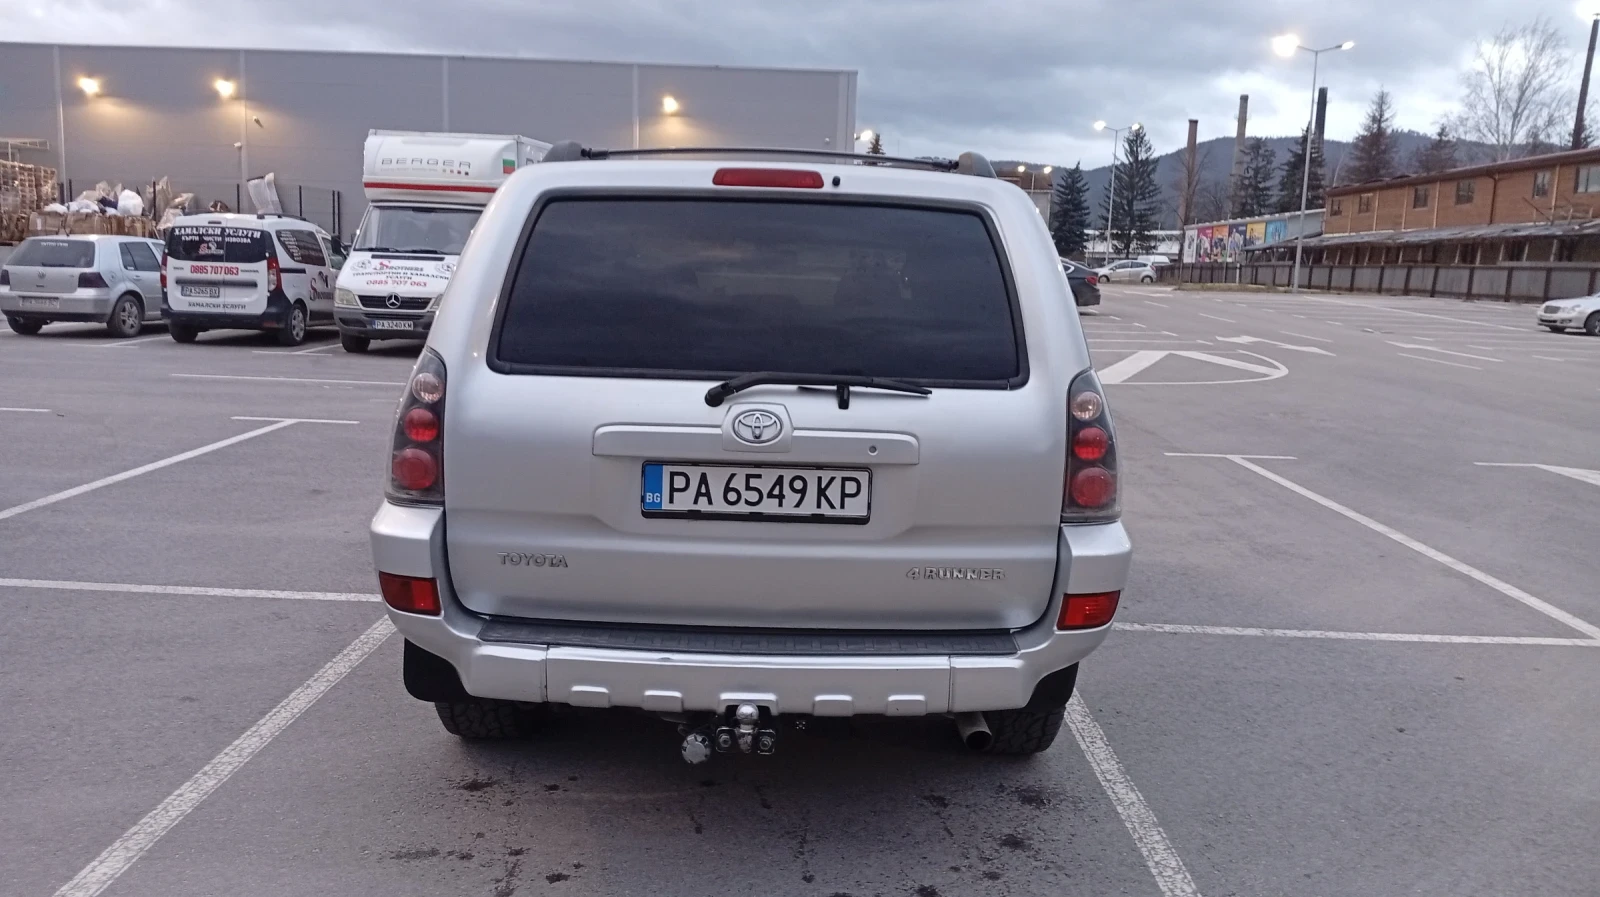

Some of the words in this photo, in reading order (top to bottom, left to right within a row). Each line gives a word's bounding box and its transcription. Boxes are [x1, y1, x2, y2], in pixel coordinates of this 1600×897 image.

[381, 158, 471, 169] BERGER
[174, 227, 222, 235] ХАМАЛСКИ
[224, 228, 262, 239] УСЛУГИ
[190, 265, 209, 274] 0885
[210, 265, 223, 275] 707
[224, 266, 239, 276] 063
[646, 492, 661, 503] BG
[497, 552, 569, 568] TOYOTA
